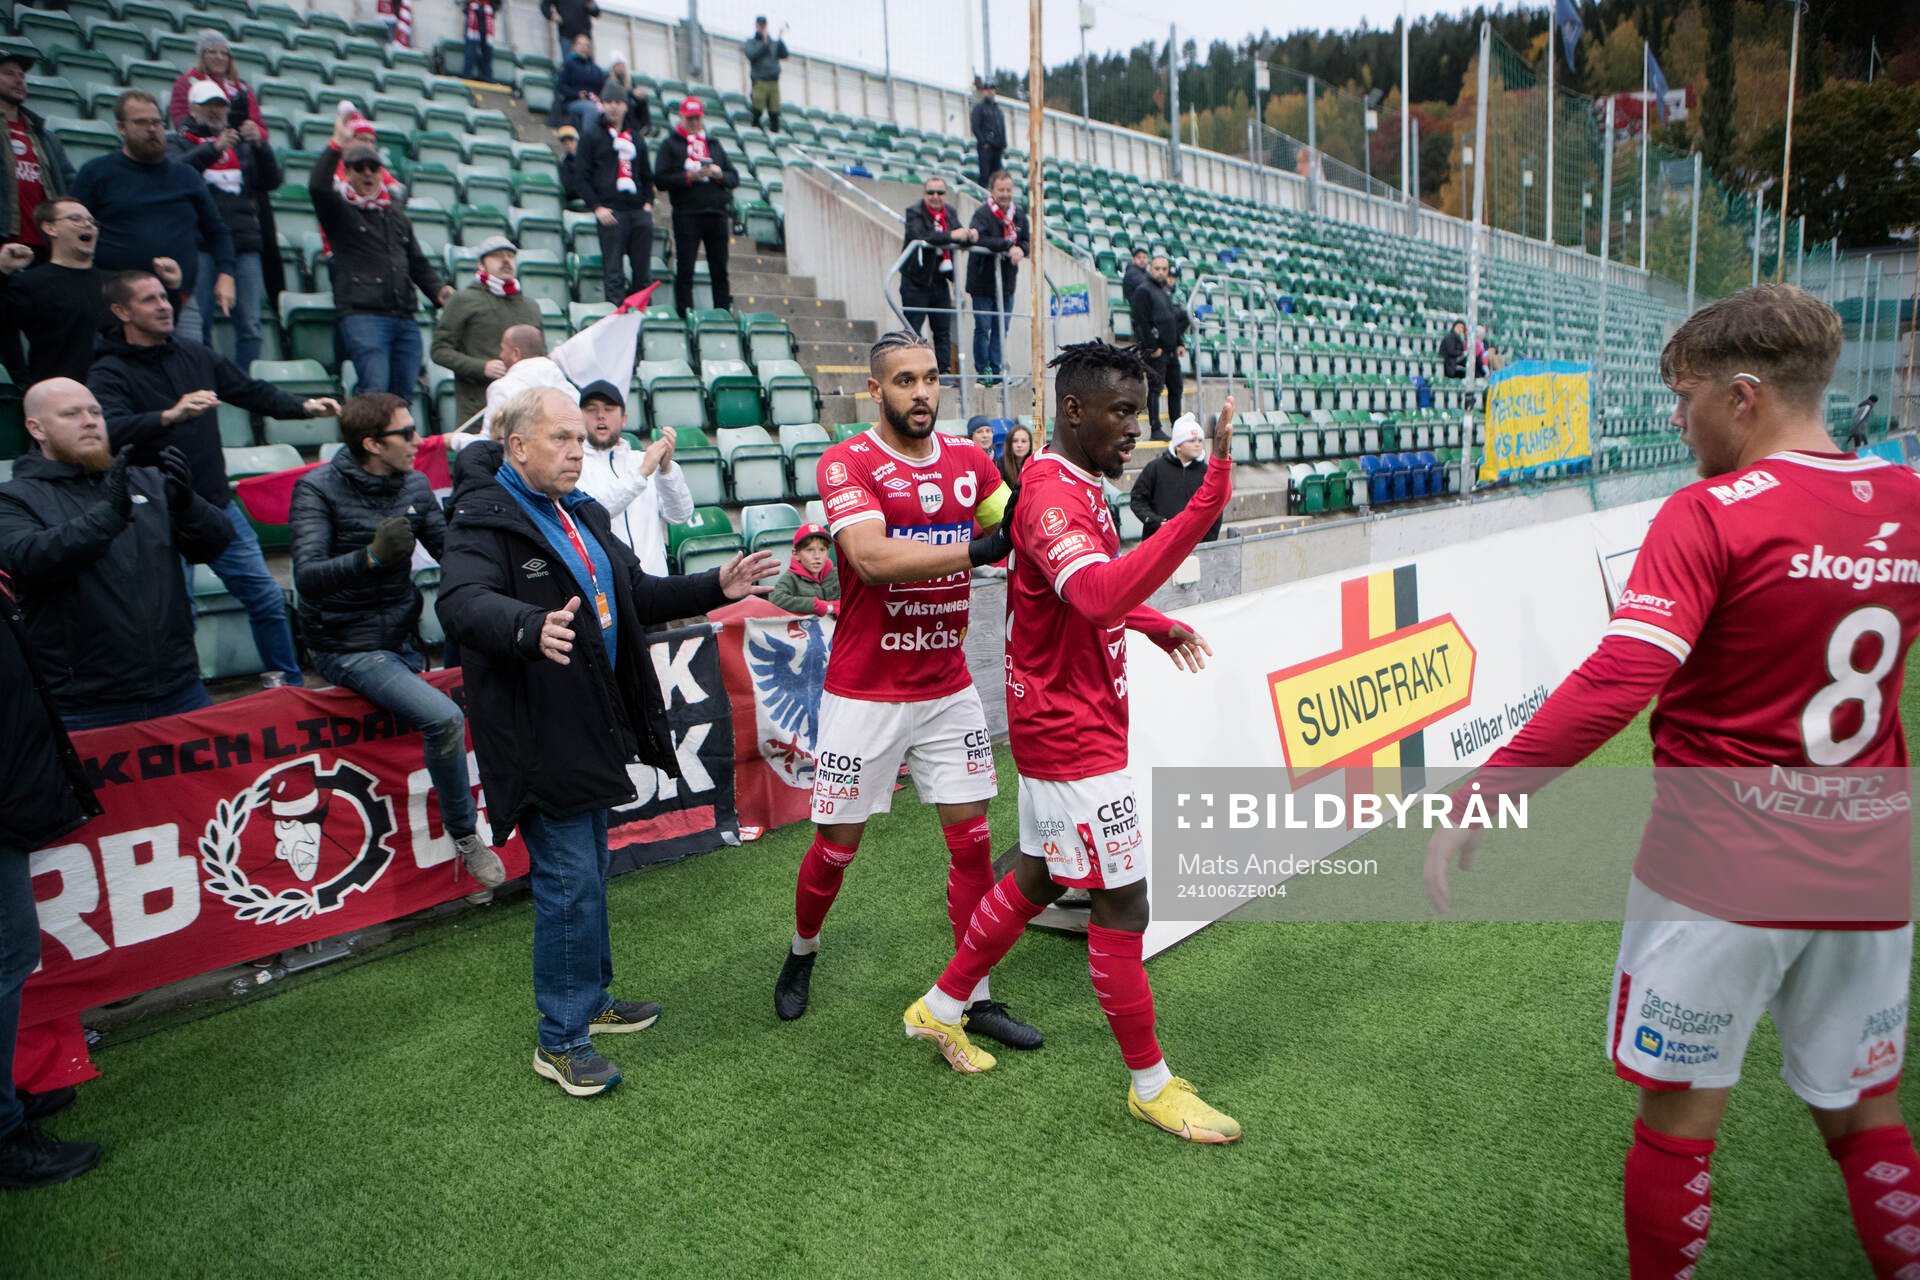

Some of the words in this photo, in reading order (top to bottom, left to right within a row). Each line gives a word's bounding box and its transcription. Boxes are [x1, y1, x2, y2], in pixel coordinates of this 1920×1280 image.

[827, 490, 863, 508] UNIBET
[1707, 470, 1777, 502] MAXI
[892, 524, 971, 545] Helmia
[1047, 534, 1086, 560] UNIBET
[526, 570, 549, 579] umbro
[904, 599, 971, 616] VÄSTANHED
[880, 621, 959, 651] askås
[1297, 643, 1452, 746] SUNDFRAKT
[1801, 605, 1900, 767] 8
[963, 727, 990, 748] CEO
[1450, 714, 1504, 761] Hållbar
[820, 751, 862, 773] CEOS
[967, 746, 991, 761] FRITZ
[816, 783, 860, 798] D-LAB
[1732, 781, 1912, 822] WELLNESS
[818, 799, 834, 815] 30
[1097, 795, 1137, 823] CEO
[1105, 829, 1143, 855] D-LA
[1074, 846, 1084, 872] umbro
[1123, 854, 1134, 871] 2
[1640, 1002, 1720, 1036] gruppen
[1645, 988, 1733, 1027] factoring
